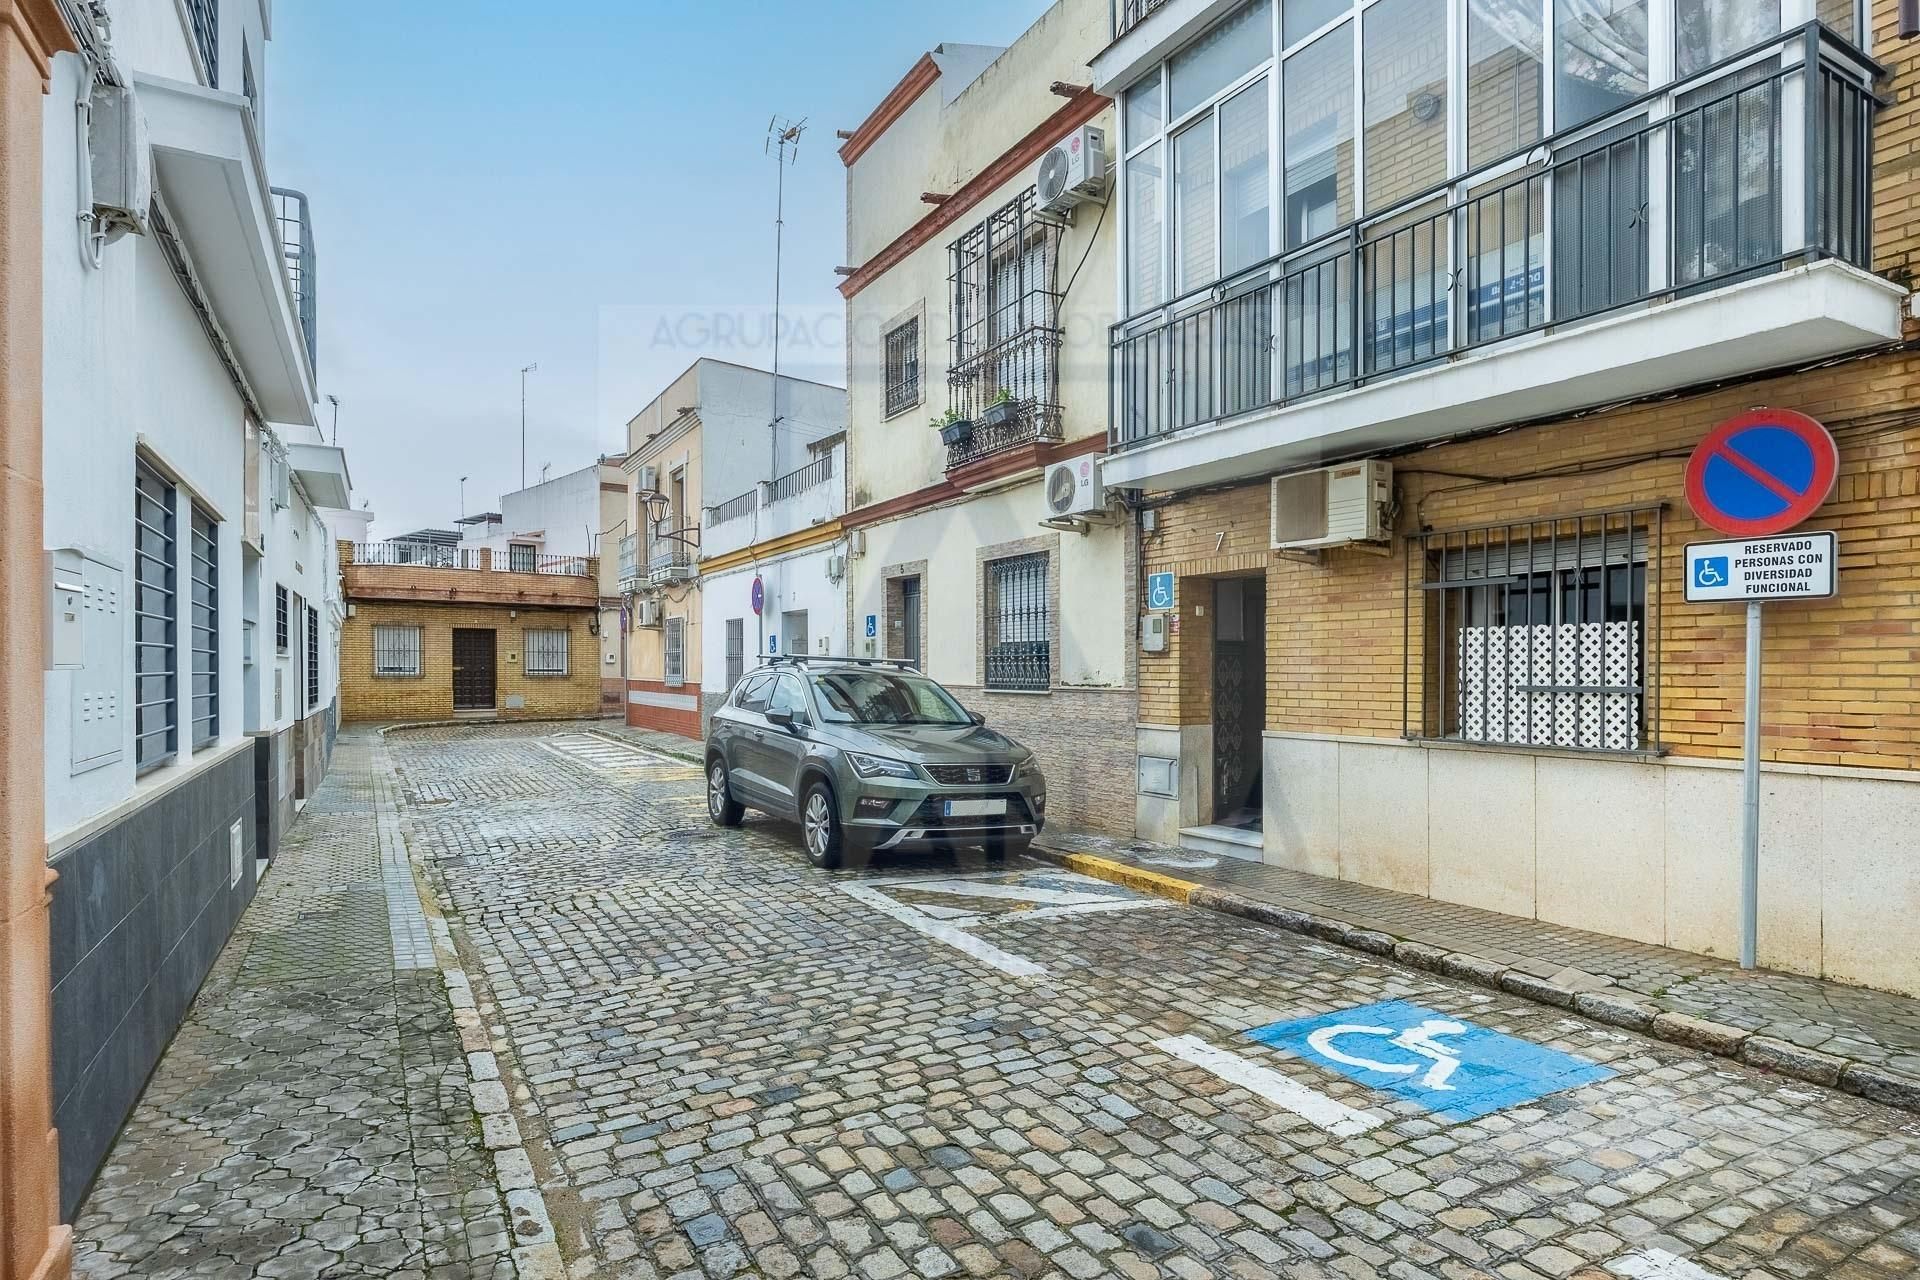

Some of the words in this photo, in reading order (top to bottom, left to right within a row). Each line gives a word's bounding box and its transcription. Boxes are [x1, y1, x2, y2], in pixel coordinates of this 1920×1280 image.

[1072, 154, 1080, 164] LG
[1080, 478, 1089, 487] LG
[1215, 531, 1225, 551] 7
[1744, 540, 1812, 554] RESERVADO
[1735, 555, 1794, 568] PERSONAS
[1797, 553, 1823, 565] CON
[899, 564, 905, 574] 5
[1744, 568, 1813, 581] DIVERSIDAD
[1745, 582, 1811, 594] FUNCIONAL
